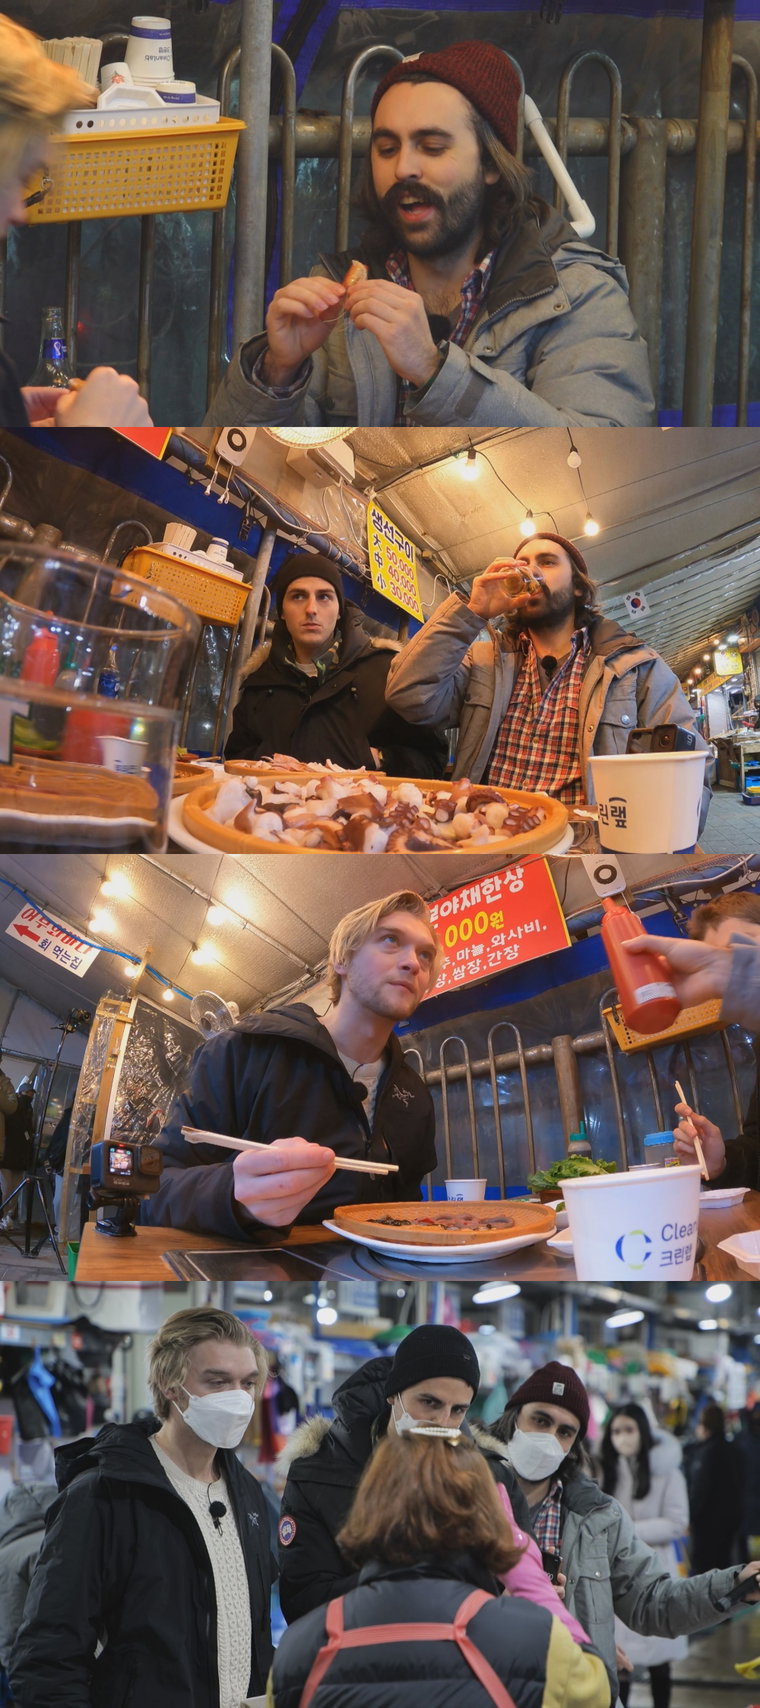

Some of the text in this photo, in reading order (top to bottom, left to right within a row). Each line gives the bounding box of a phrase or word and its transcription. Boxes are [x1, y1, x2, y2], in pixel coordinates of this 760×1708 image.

[371, 508, 414, 563] 생선구이
[598, 802, 627, 829] 린랲
[445, 910, 504, 948] 000원
[38, 938, 83, 970] 회 먹는집
